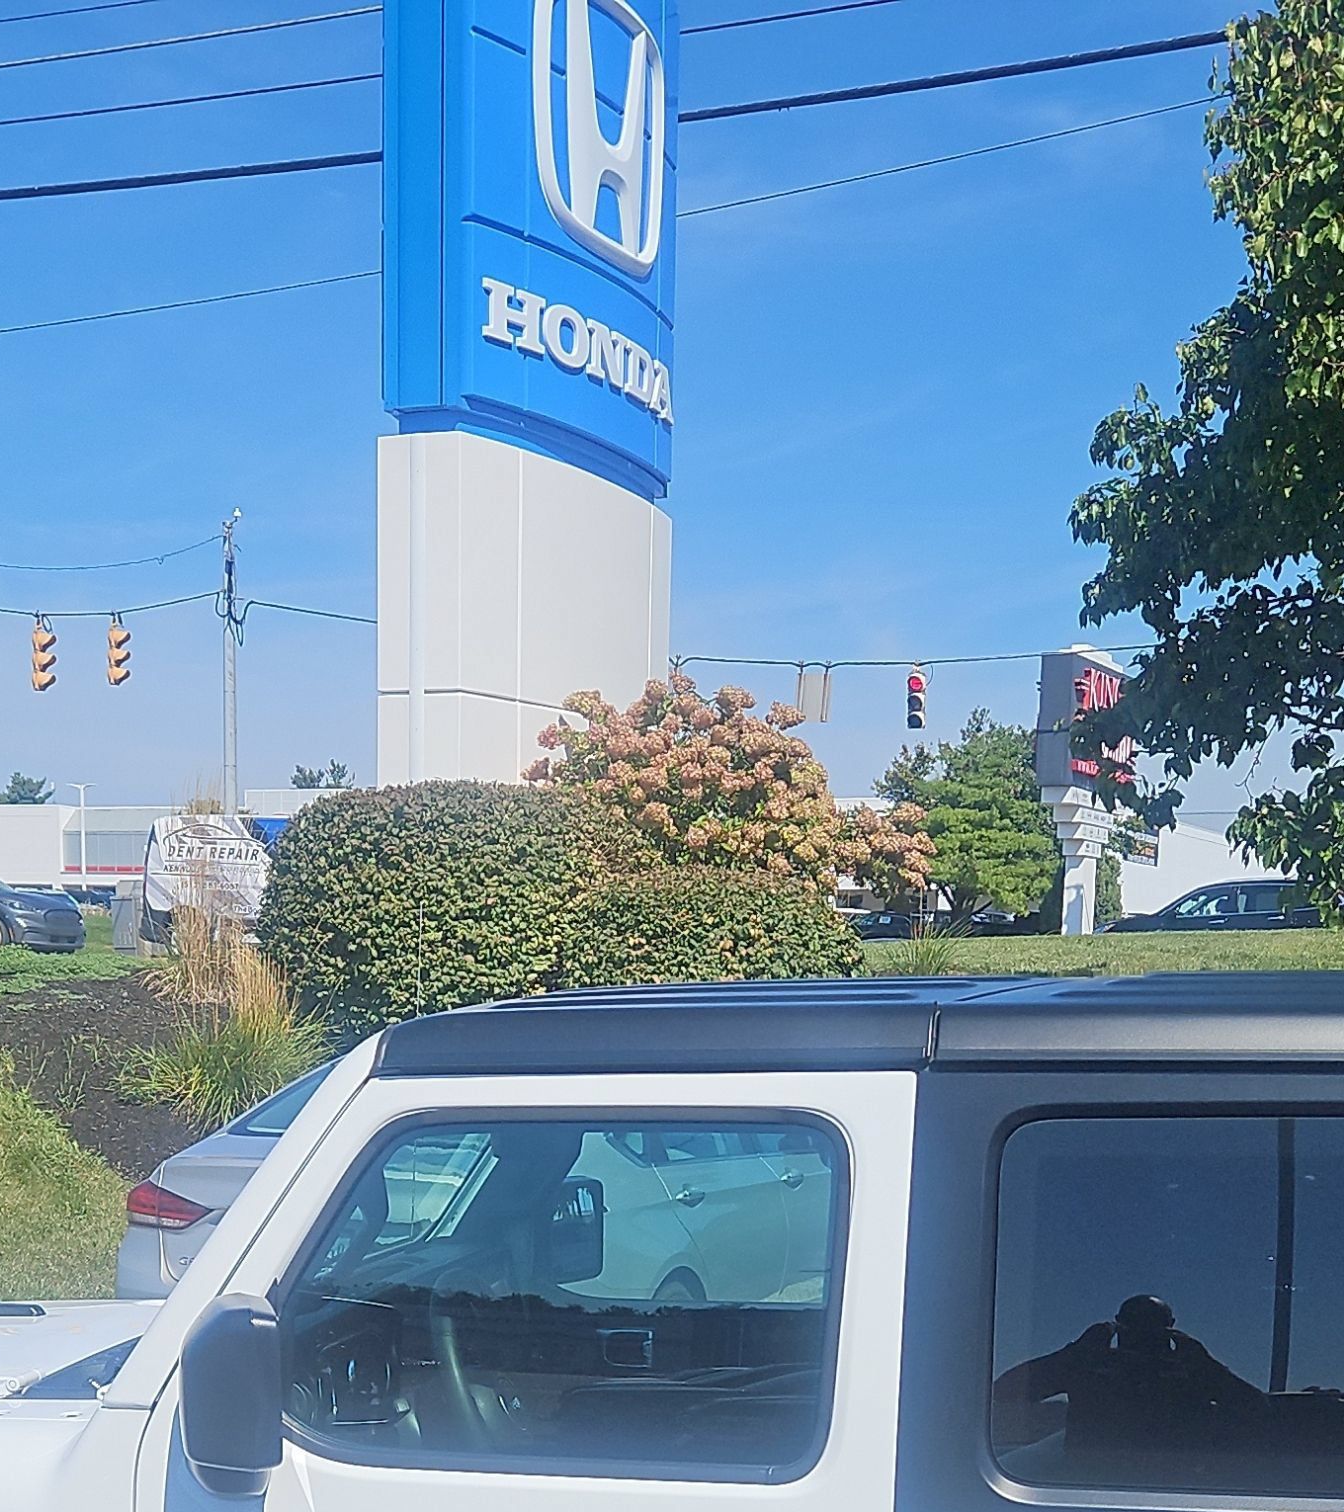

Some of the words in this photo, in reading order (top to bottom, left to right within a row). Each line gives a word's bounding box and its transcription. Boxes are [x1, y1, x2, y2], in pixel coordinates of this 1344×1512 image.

[481, 276, 674, 426] HONDA
[1089, 667, 1125, 712] KIN
[167, 844, 204, 859] DENT
[209, 847, 260, 862] REPAIR
